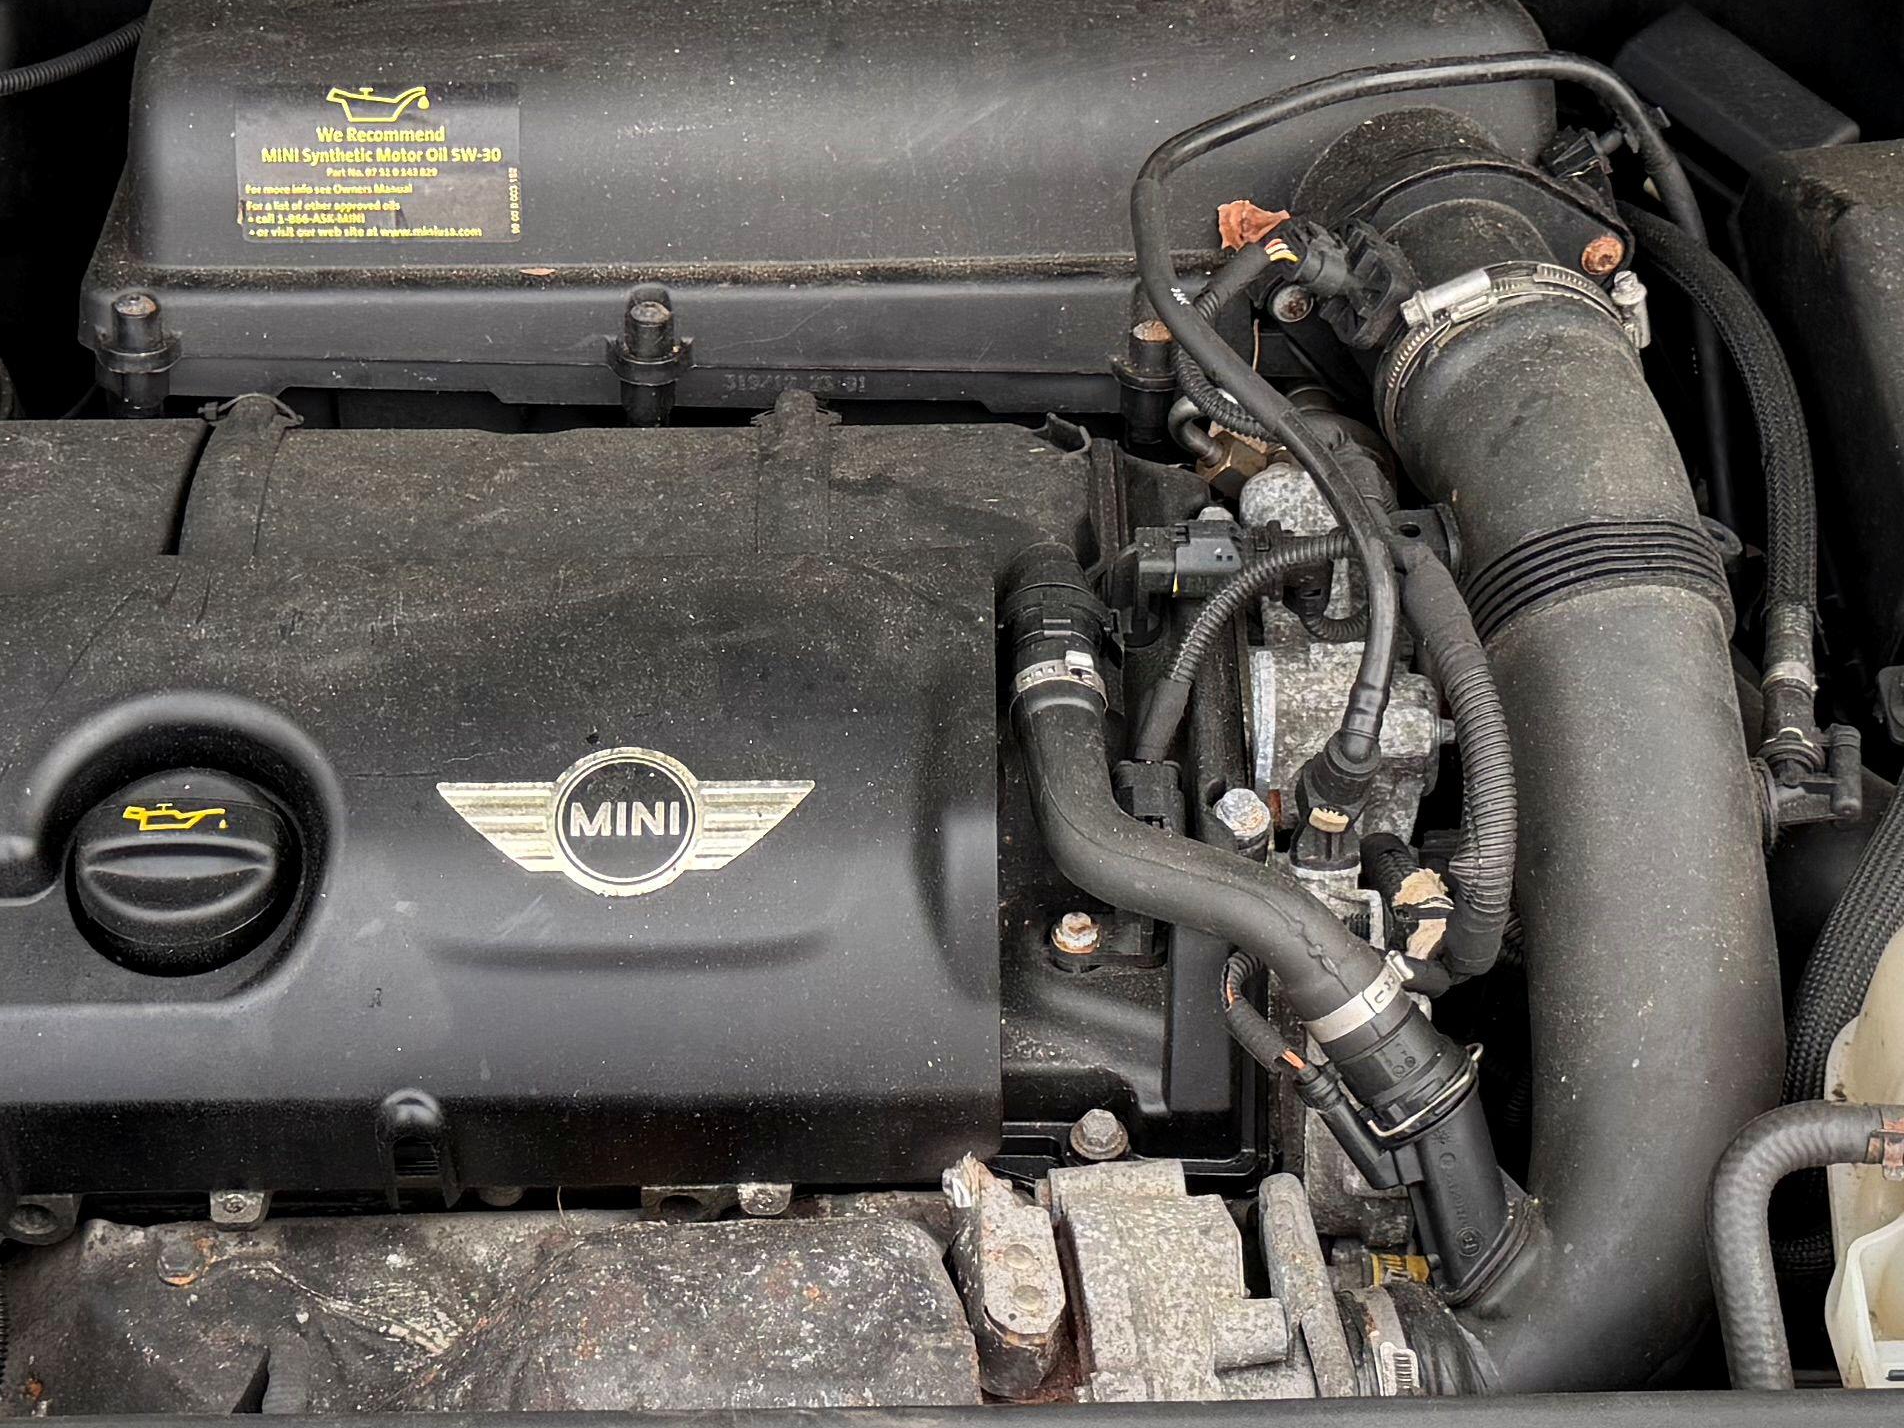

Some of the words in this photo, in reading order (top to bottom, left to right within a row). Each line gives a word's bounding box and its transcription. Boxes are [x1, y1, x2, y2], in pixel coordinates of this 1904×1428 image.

[316, 126, 344, 143] We
[347, 126, 446, 143] Recommend
[261, 148, 299, 164] MINI
[302, 147, 372, 166] Synthetic
[376, 148, 423, 163] Motor
[426, 147, 448, 163] Oil
[451, 147, 502, 163] 5W-30
[570, 800, 680, 837] MINI
